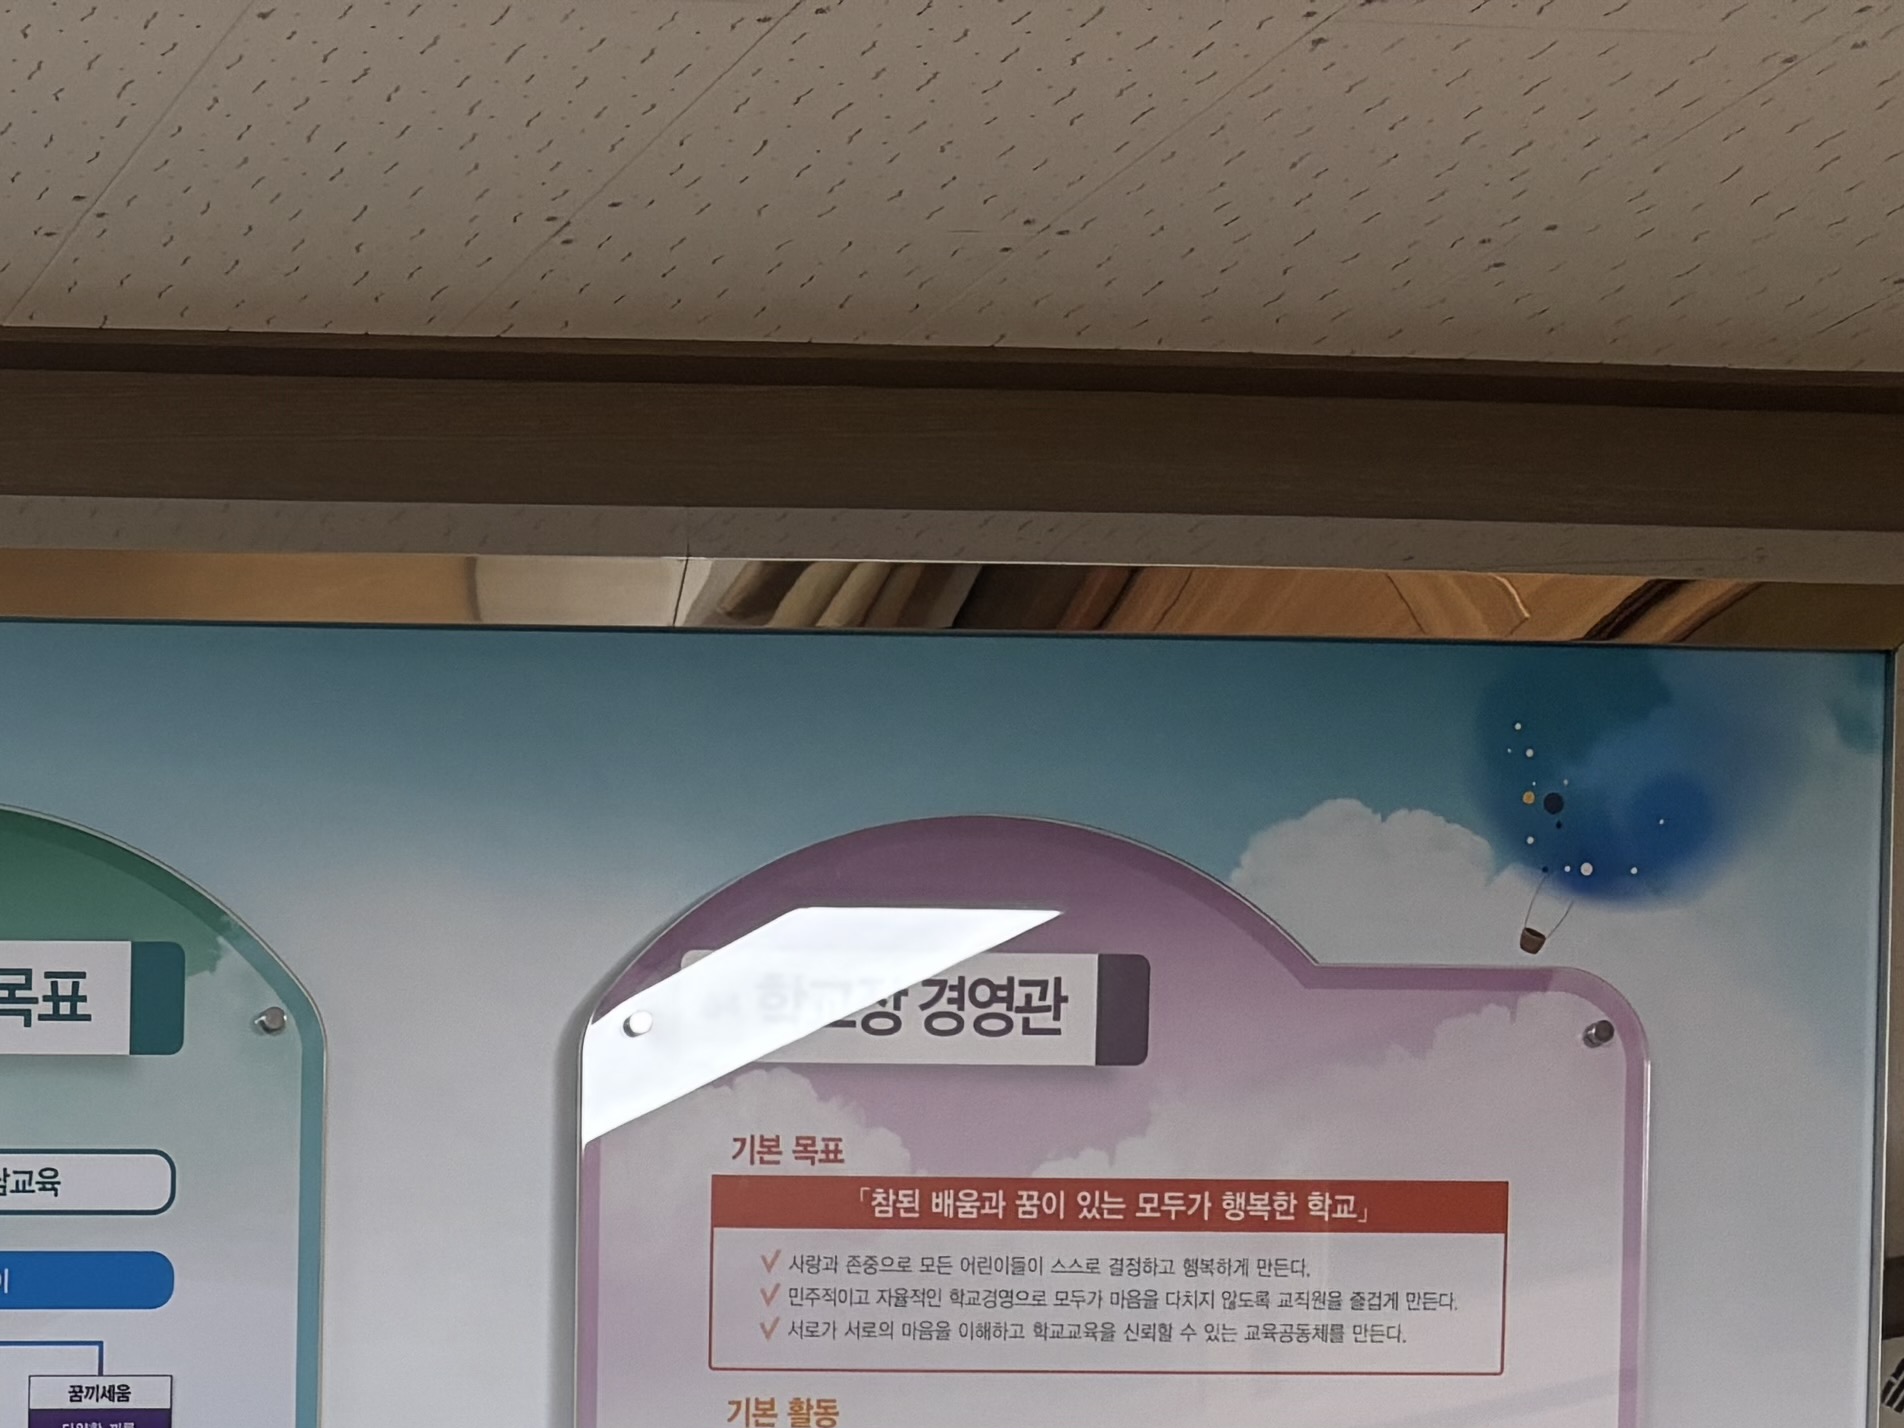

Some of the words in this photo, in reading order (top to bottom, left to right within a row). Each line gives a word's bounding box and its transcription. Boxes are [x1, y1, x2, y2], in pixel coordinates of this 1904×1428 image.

[918, 976, 1069, 1037] 경영관
[732, 1134, 783, 1166] 기본
[792, 1136, 845, 1166] 목표
[860, 1187, 919, 1217] 「참된
[932, 1189, 1006, 1219] 배움과
[1015, 1190, 1064, 1219] 꿈이
[1077, 1190, 1126, 1219] 있는
[1136, 1191, 1212, 1221] 모두가
[1222, 1191, 1298, 1221] 행복한
[1307, 1191, 1367, 1223] 학교」
[789, 1254, 838, 1275] 사랑과
[846, 1255, 913, 1275] 존중으로
[919, 1256, 953, 1275] 모든
[961, 1256, 1043, 1276] 어린이들이
[1050, 1258, 1101, 1274] 스스로
[1109, 1256, 1176, 1277] 결정하고
[1183, 1256, 1249, 1278] 행복하게
[1256, 1258, 1310, 1278] 만든다.
[68, 1384, 131, 1403] 꿈끼세움
[727, 1397, 778, 1428] 기본
[787, 1397, 839, 1428] 활동
